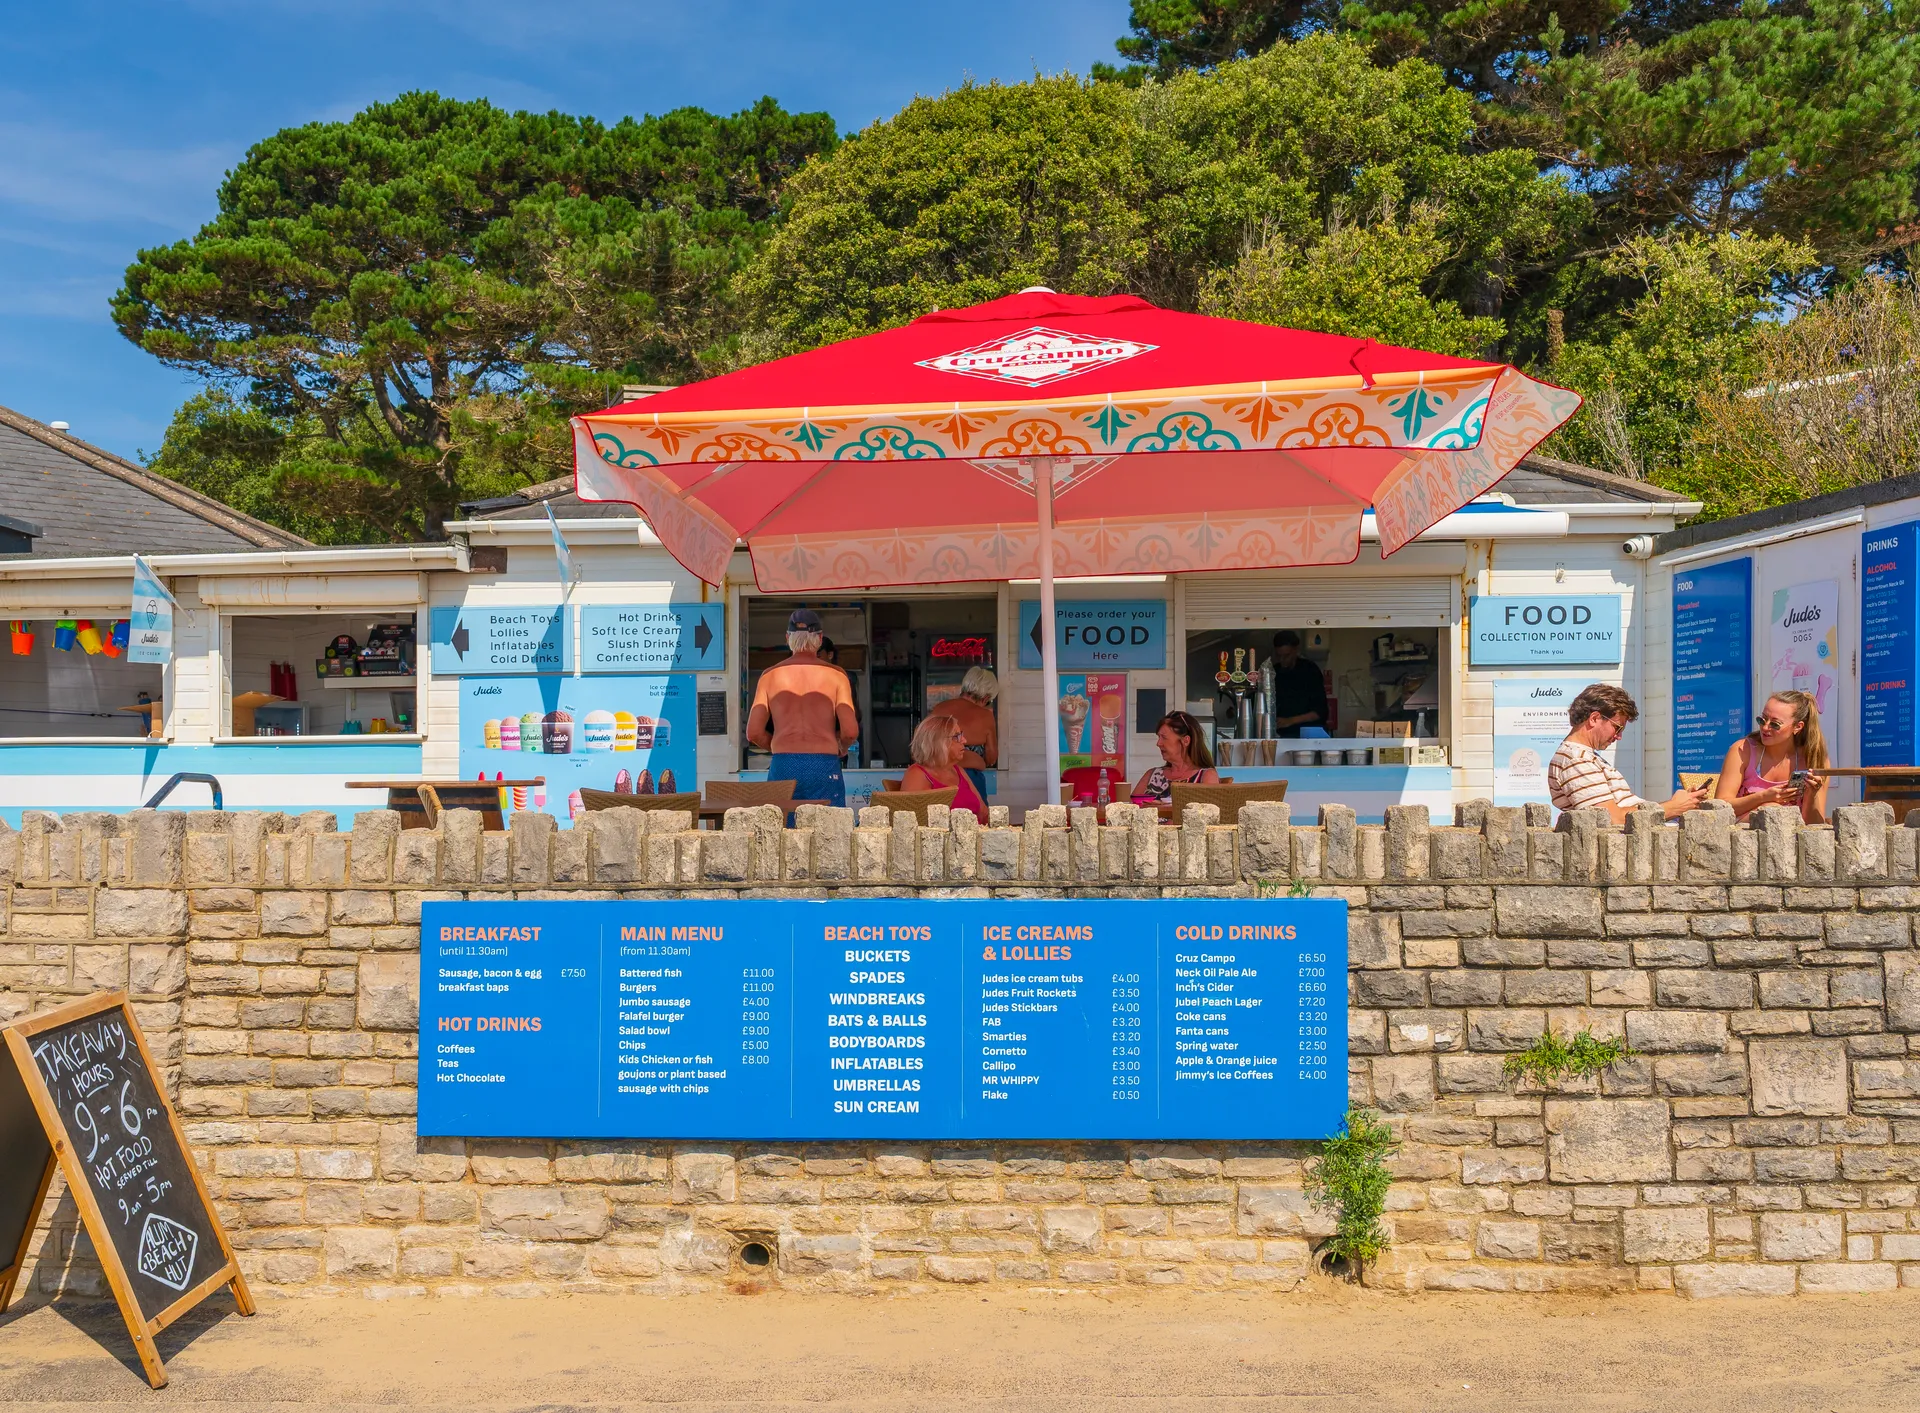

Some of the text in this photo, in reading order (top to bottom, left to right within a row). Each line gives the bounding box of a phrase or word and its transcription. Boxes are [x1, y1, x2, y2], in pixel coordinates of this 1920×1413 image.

[950, 346, 1123, 367] Cruzcampo
[1009, 359, 1064, 367] SEVILLA
[1867, 538, 1898, 553] DRINKS
[1866, 562, 1897, 575] ALCOHOL
[1677, 581, 1694, 592] FOOD
[490, 614, 560, 625] Beach Toys
[619, 612, 682, 622] Hot Drinks
[1057, 609, 1156, 621] Please order your
[1505, 605, 1592, 626] FOOD
[1783, 606, 1821, 628] Jude's
[490, 628, 529, 637] Lollies
[592, 625, 682, 636] Soft Ice Cream
[1064, 626, 1150, 646] FOOD
[141, 633, 159, 644] Jude's
[1480, 631, 1613, 642] COLLECTION POINT ONLY
[1793, 633, 1813, 643] DOGS
[490, 640, 554, 651] Inflatables
[608, 638, 682, 649] Slush Drinks
[490, 653, 559, 664] Cold Drinks
[597, 652, 682, 664] Confectionary
[1093, 652, 1119, 660] Here
[473, 686, 502, 696] Jude's
[1866, 680, 1906, 691] HOT DRINKS
[1530, 687, 1563, 698] Jude's
[1677, 694, 1694, 702] LUNCH
[440, 927, 541, 941] BREAKFAST
[621, 927, 723, 941] MAIN MENU
[825, 926, 931, 940] BEACH TOYS
[983, 926, 1093, 940] ICE CREAMS
[1176, 925, 1296, 940] COLD DRINKS
[439, 946, 508, 957] (until 11.30am)
[620, 946, 691, 957] (from 11.30am)
[845, 950, 910, 962] BUCKETS
[983, 946, 1071, 960] & LOLLIES
[1176, 954, 1325, 964] Cruz Campo £6.50
[439, 969, 585, 979] Sausage, bacon & egg £7.50
[620, 969, 774, 977] Battered fish £11.00
[850, 972, 905, 983] SPADES
[982, 974, 1009, 984] Judes
[1012, 974, 1025, 982] ice
[1061, 974, 1083, 982] tubs
[1113, 974, 1139, 982] £4.00
[439, 983, 509, 993] breakfast baps
[620, 983, 656, 993] Burgers
[1176, 981, 1233, 991] Inch's Cider
[619, 997, 690, 1008] Jumbo sausage
[830, 993, 925, 1005] WINDBREAKS
[1176, 998, 1262, 1008] Jubel Peach Lager
[620, 1012, 684, 1022] Falafel burger
[828, 1015, 926, 1026] BATS & BALLS
[983, 1018, 1001, 1026] FAB
[439, 1017, 542, 1031] HOT DRINKS
[619, 1026, 670, 1035] Salad bowl
[983, 1032, 1026, 1040] Smarties
[619, 1040, 646, 1051] Chips
[830, 1036, 925, 1048] BODYBOARDS
[34, 1021, 126, 1082] TAKEAWAY
[438, 1045, 475, 1053] Coffees
[983, 1047, 1026, 1055] Cornetto
[619, 1055, 639, 1063] Kids
[642, 1055, 680, 1064] Chicken
[695, 1055, 712, 1064] fish
[831, 1058, 923, 1070] INFLATABLES
[1176, 1056, 1277, 1066] Apple & Orange juice
[983, 1061, 1016, 1072] Callipo
[74, 1063, 114, 1098] HOURS
[437, 1074, 505, 1082] Hot Chocolate
[983, 1076, 1039, 1084] MR WHIPPY
[834, 1080, 920, 1091] UMBRELLAS
[983, 1091, 1008, 1099] Flake
[834, 1101, 919, 1113] SUN CREAM
[95, 1136, 152, 1190] HOT FOOD
[117, 1165, 142, 1190] SERVED
[145, 1221, 173, 1249] ALUM
[143, 1237, 184, 1273] BEACH
[165, 1256, 188, 1282] HUT
